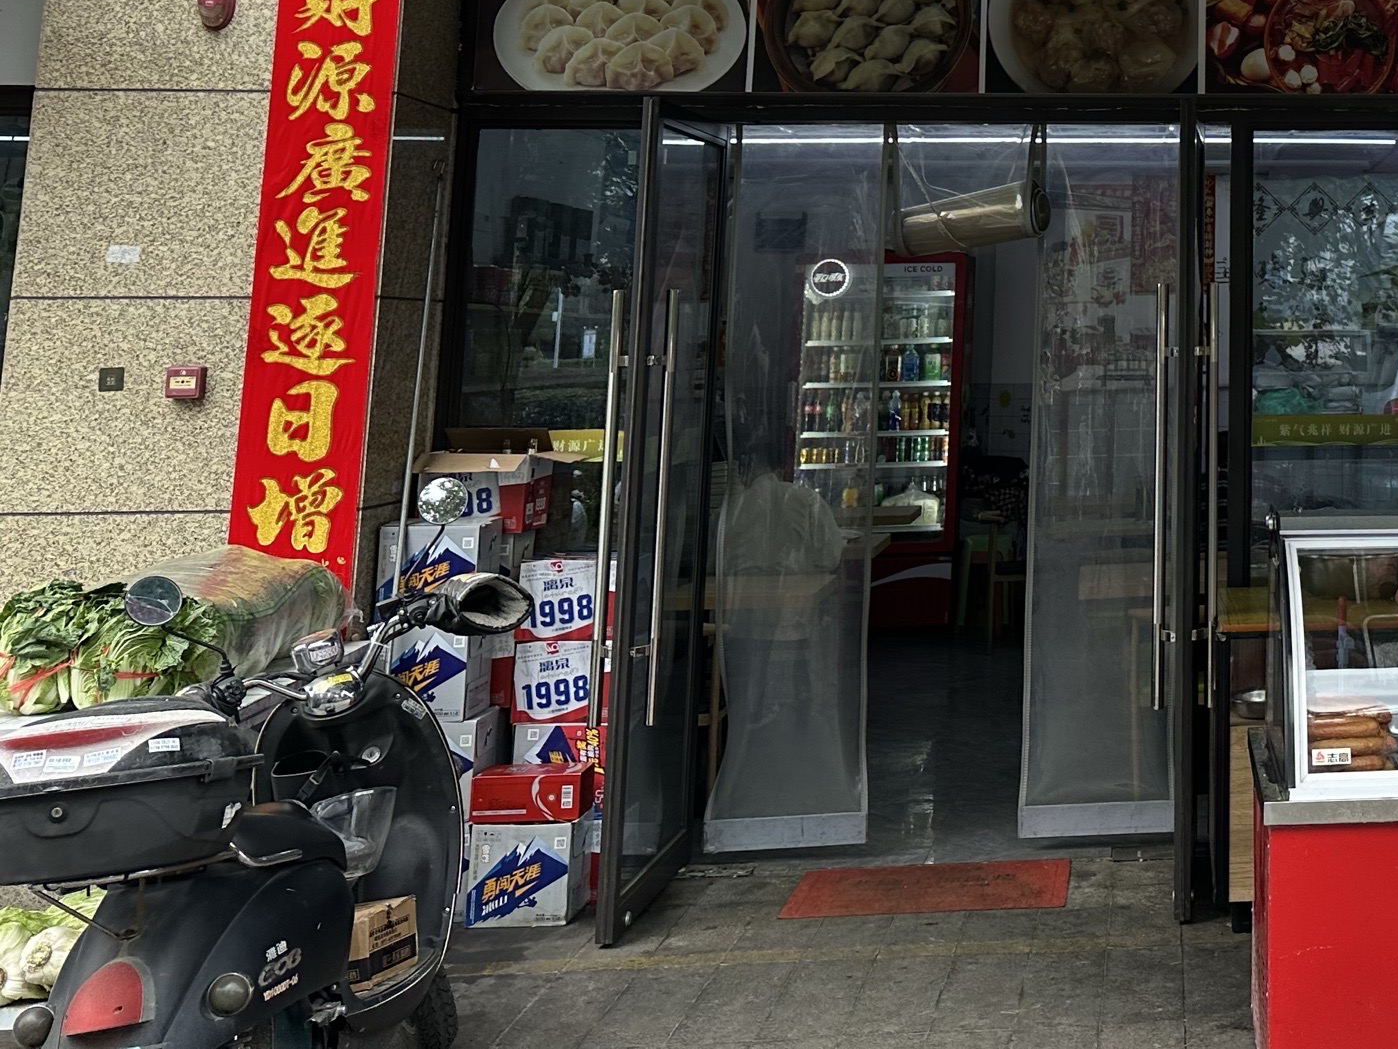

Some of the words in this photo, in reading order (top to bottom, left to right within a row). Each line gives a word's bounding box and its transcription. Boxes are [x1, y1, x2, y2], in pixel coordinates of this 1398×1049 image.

[904, 265, 918, 273] ICE
[920, 265, 944, 273] COLD
[521, 674, 590, 711] 1998
[481, 861, 542, 904] 勇闯天涯
